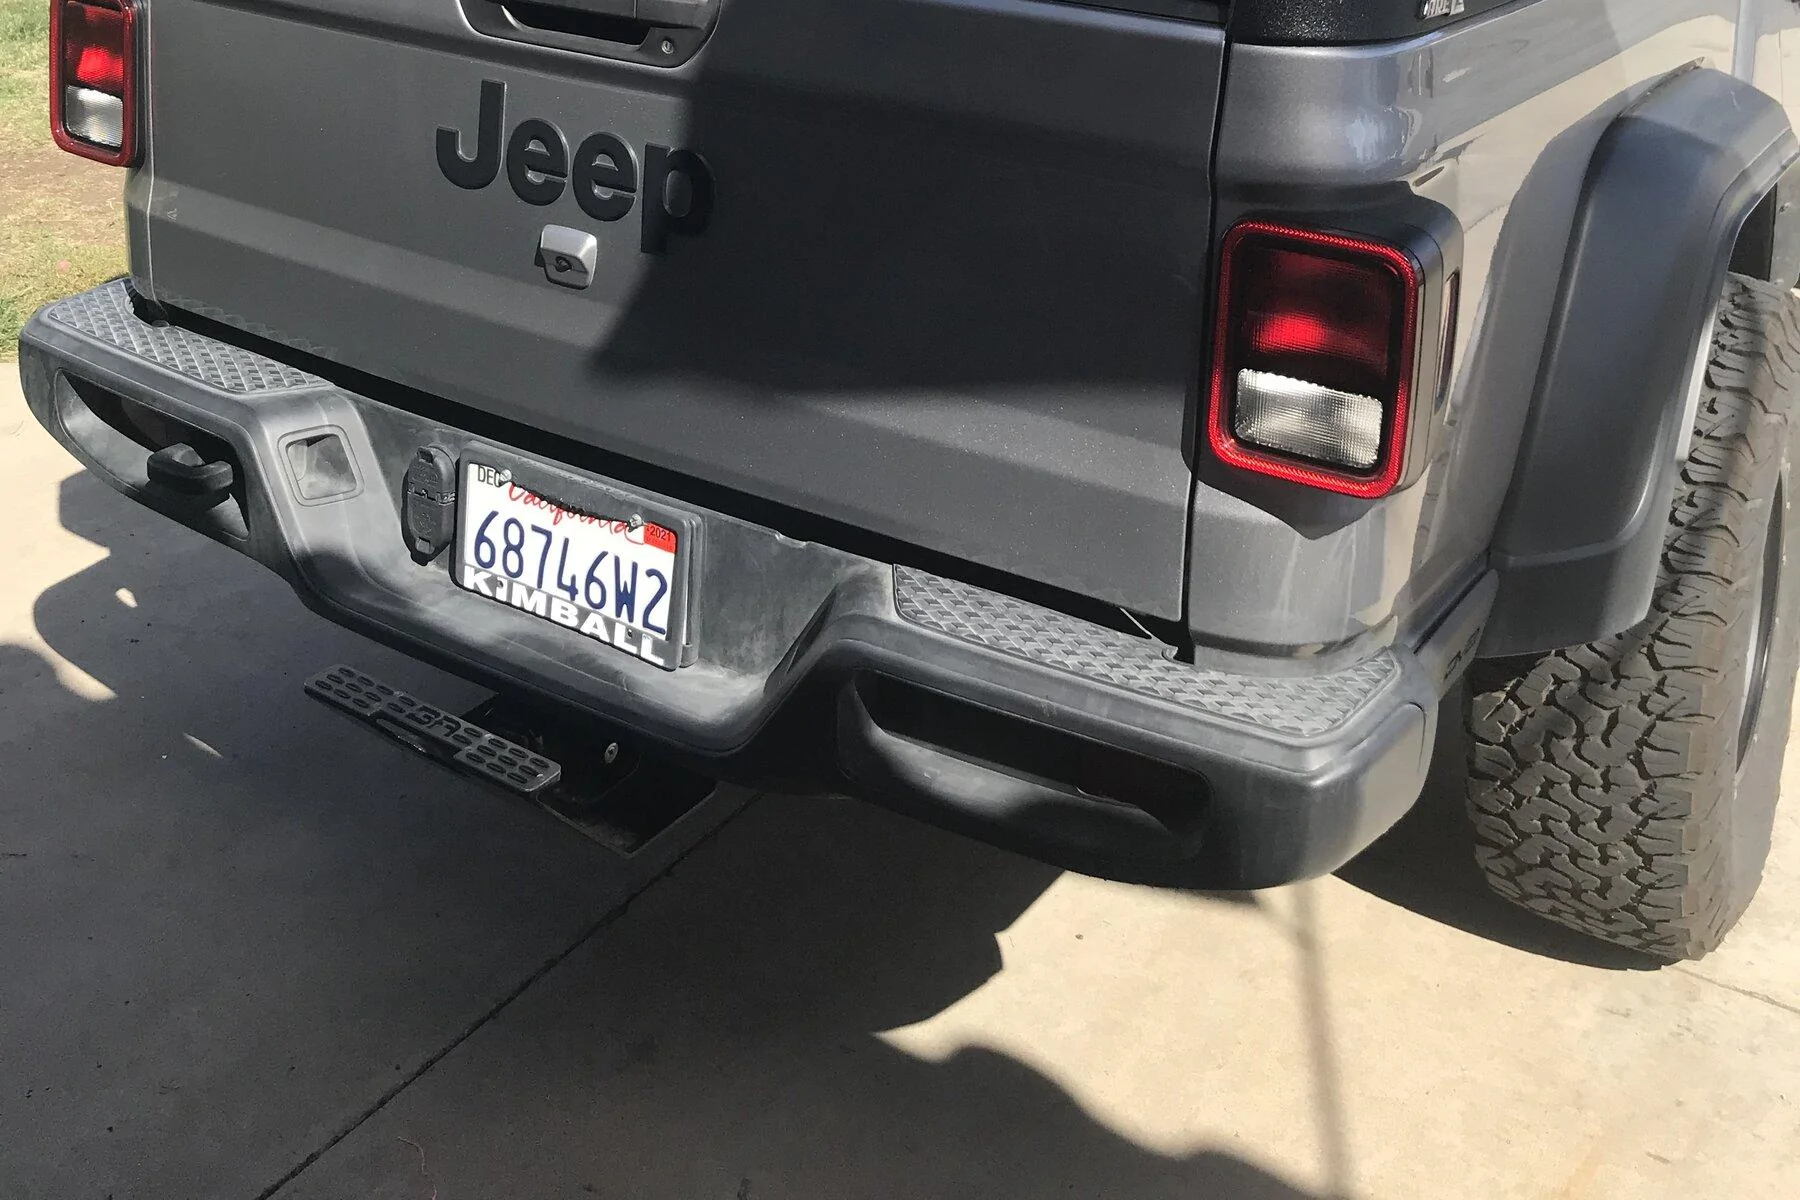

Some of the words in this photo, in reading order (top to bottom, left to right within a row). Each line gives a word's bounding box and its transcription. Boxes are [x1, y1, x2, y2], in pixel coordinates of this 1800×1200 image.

[436, 79, 714, 253] Jeep
[474, 510, 669, 636] 68746W2
[650, 525, 672, 542] 2021
[463, 565, 665, 666] KIMBALL
